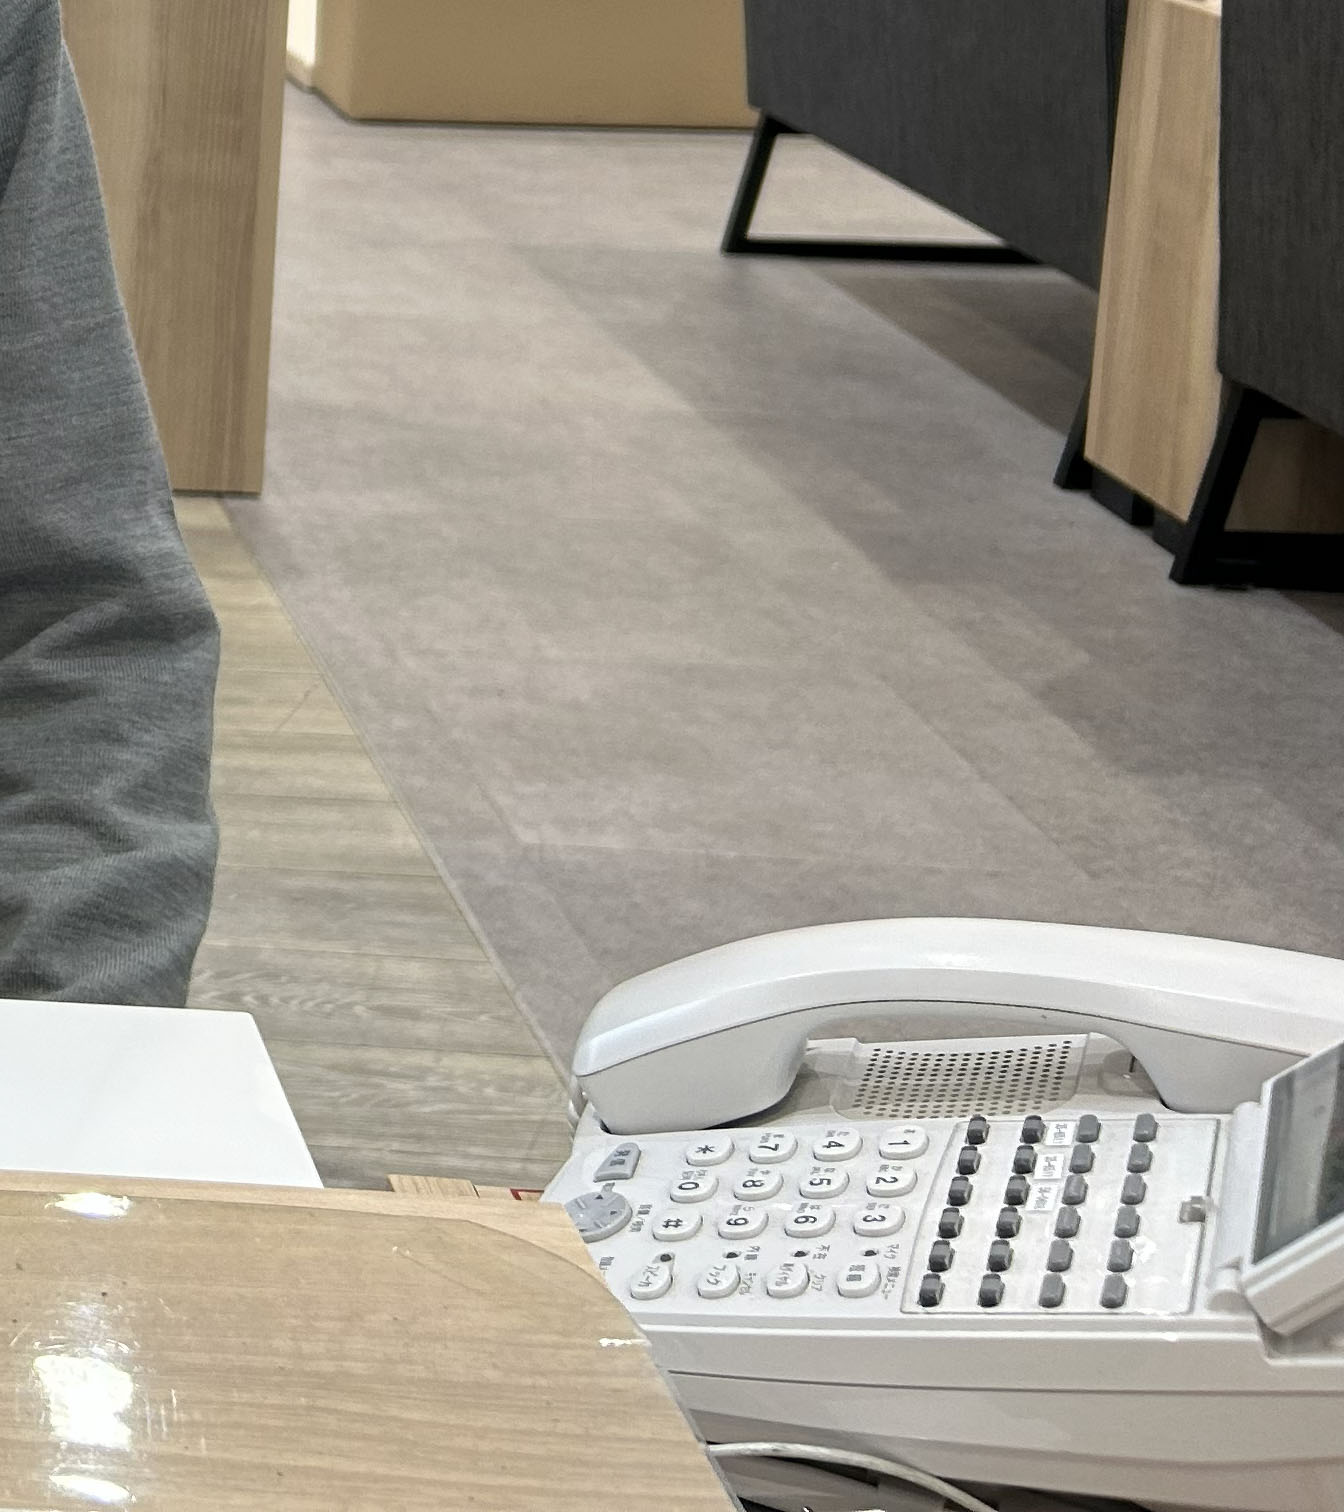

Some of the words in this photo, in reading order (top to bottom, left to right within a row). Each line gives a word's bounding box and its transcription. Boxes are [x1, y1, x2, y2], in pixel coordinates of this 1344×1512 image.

[821, 1139, 845, 1149] 4
[742, 1179, 765, 1189] 8
[809, 1177, 832, 1187] 5
[875, 1176, 899, 1185] 2
[678, 1181, 700, 1191] 0
[726, 1217, 749, 1227] 9
[794, 1215, 817, 1225] 6
[862, 1215, 886, 1224] 3
